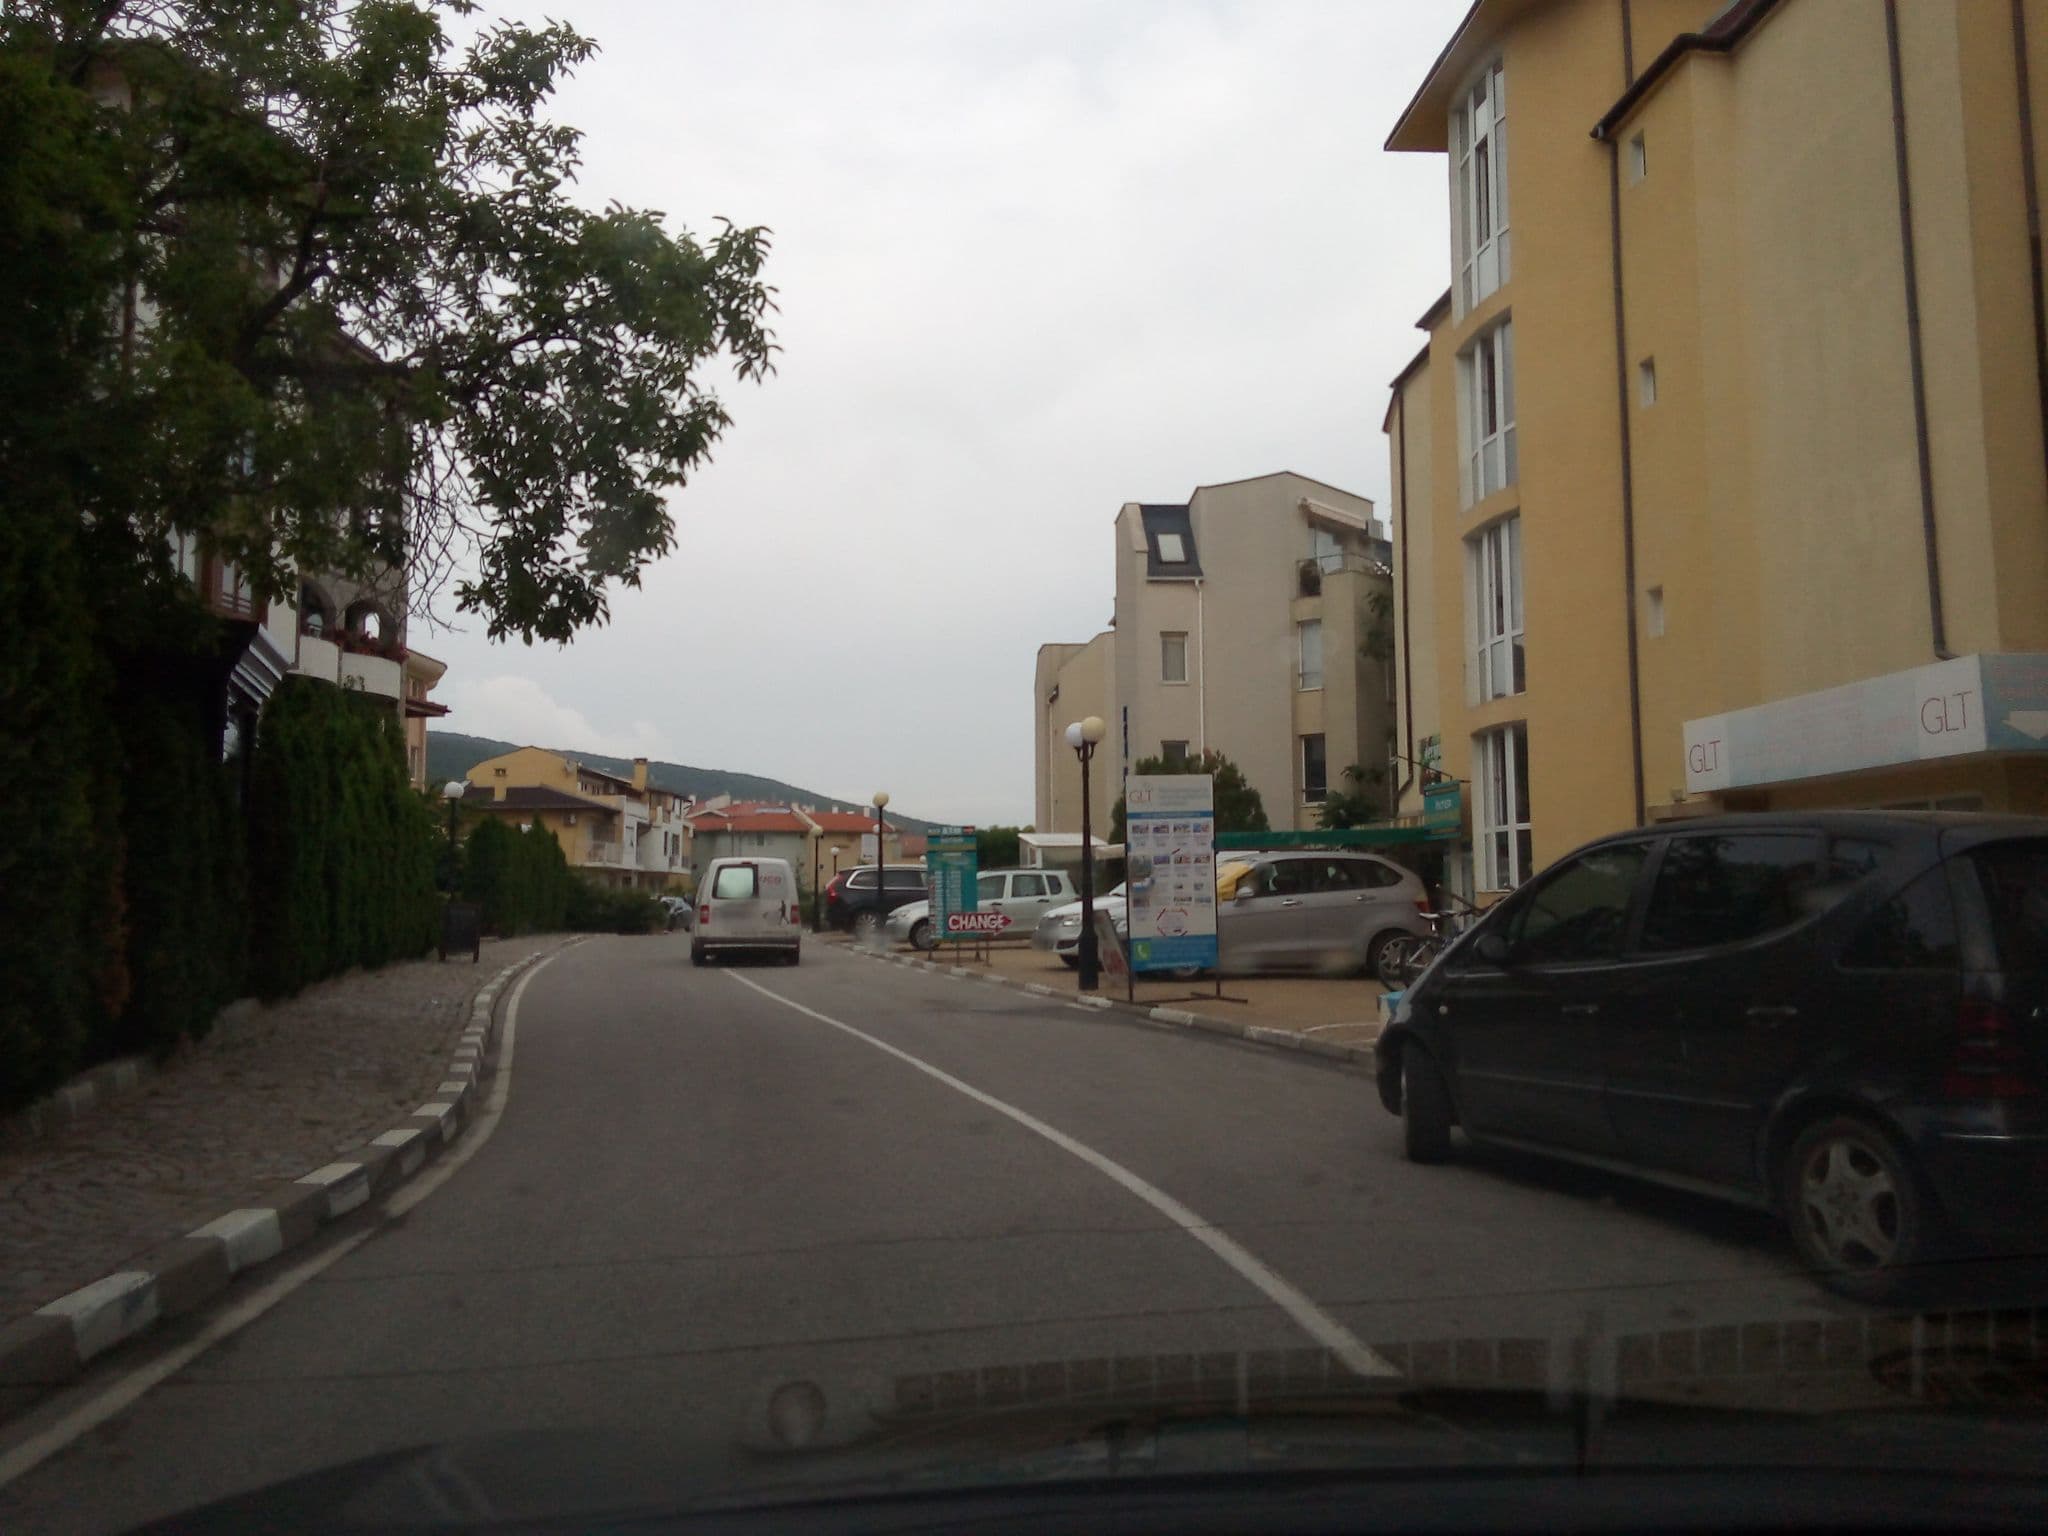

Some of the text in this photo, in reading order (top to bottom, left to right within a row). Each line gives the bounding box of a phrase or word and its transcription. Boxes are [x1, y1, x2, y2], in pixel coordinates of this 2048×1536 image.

[1920, 690, 1973, 735] GLT
[1689, 740, 1721, 774] GLT
[948, 914, 1004, 930] CHANGE
